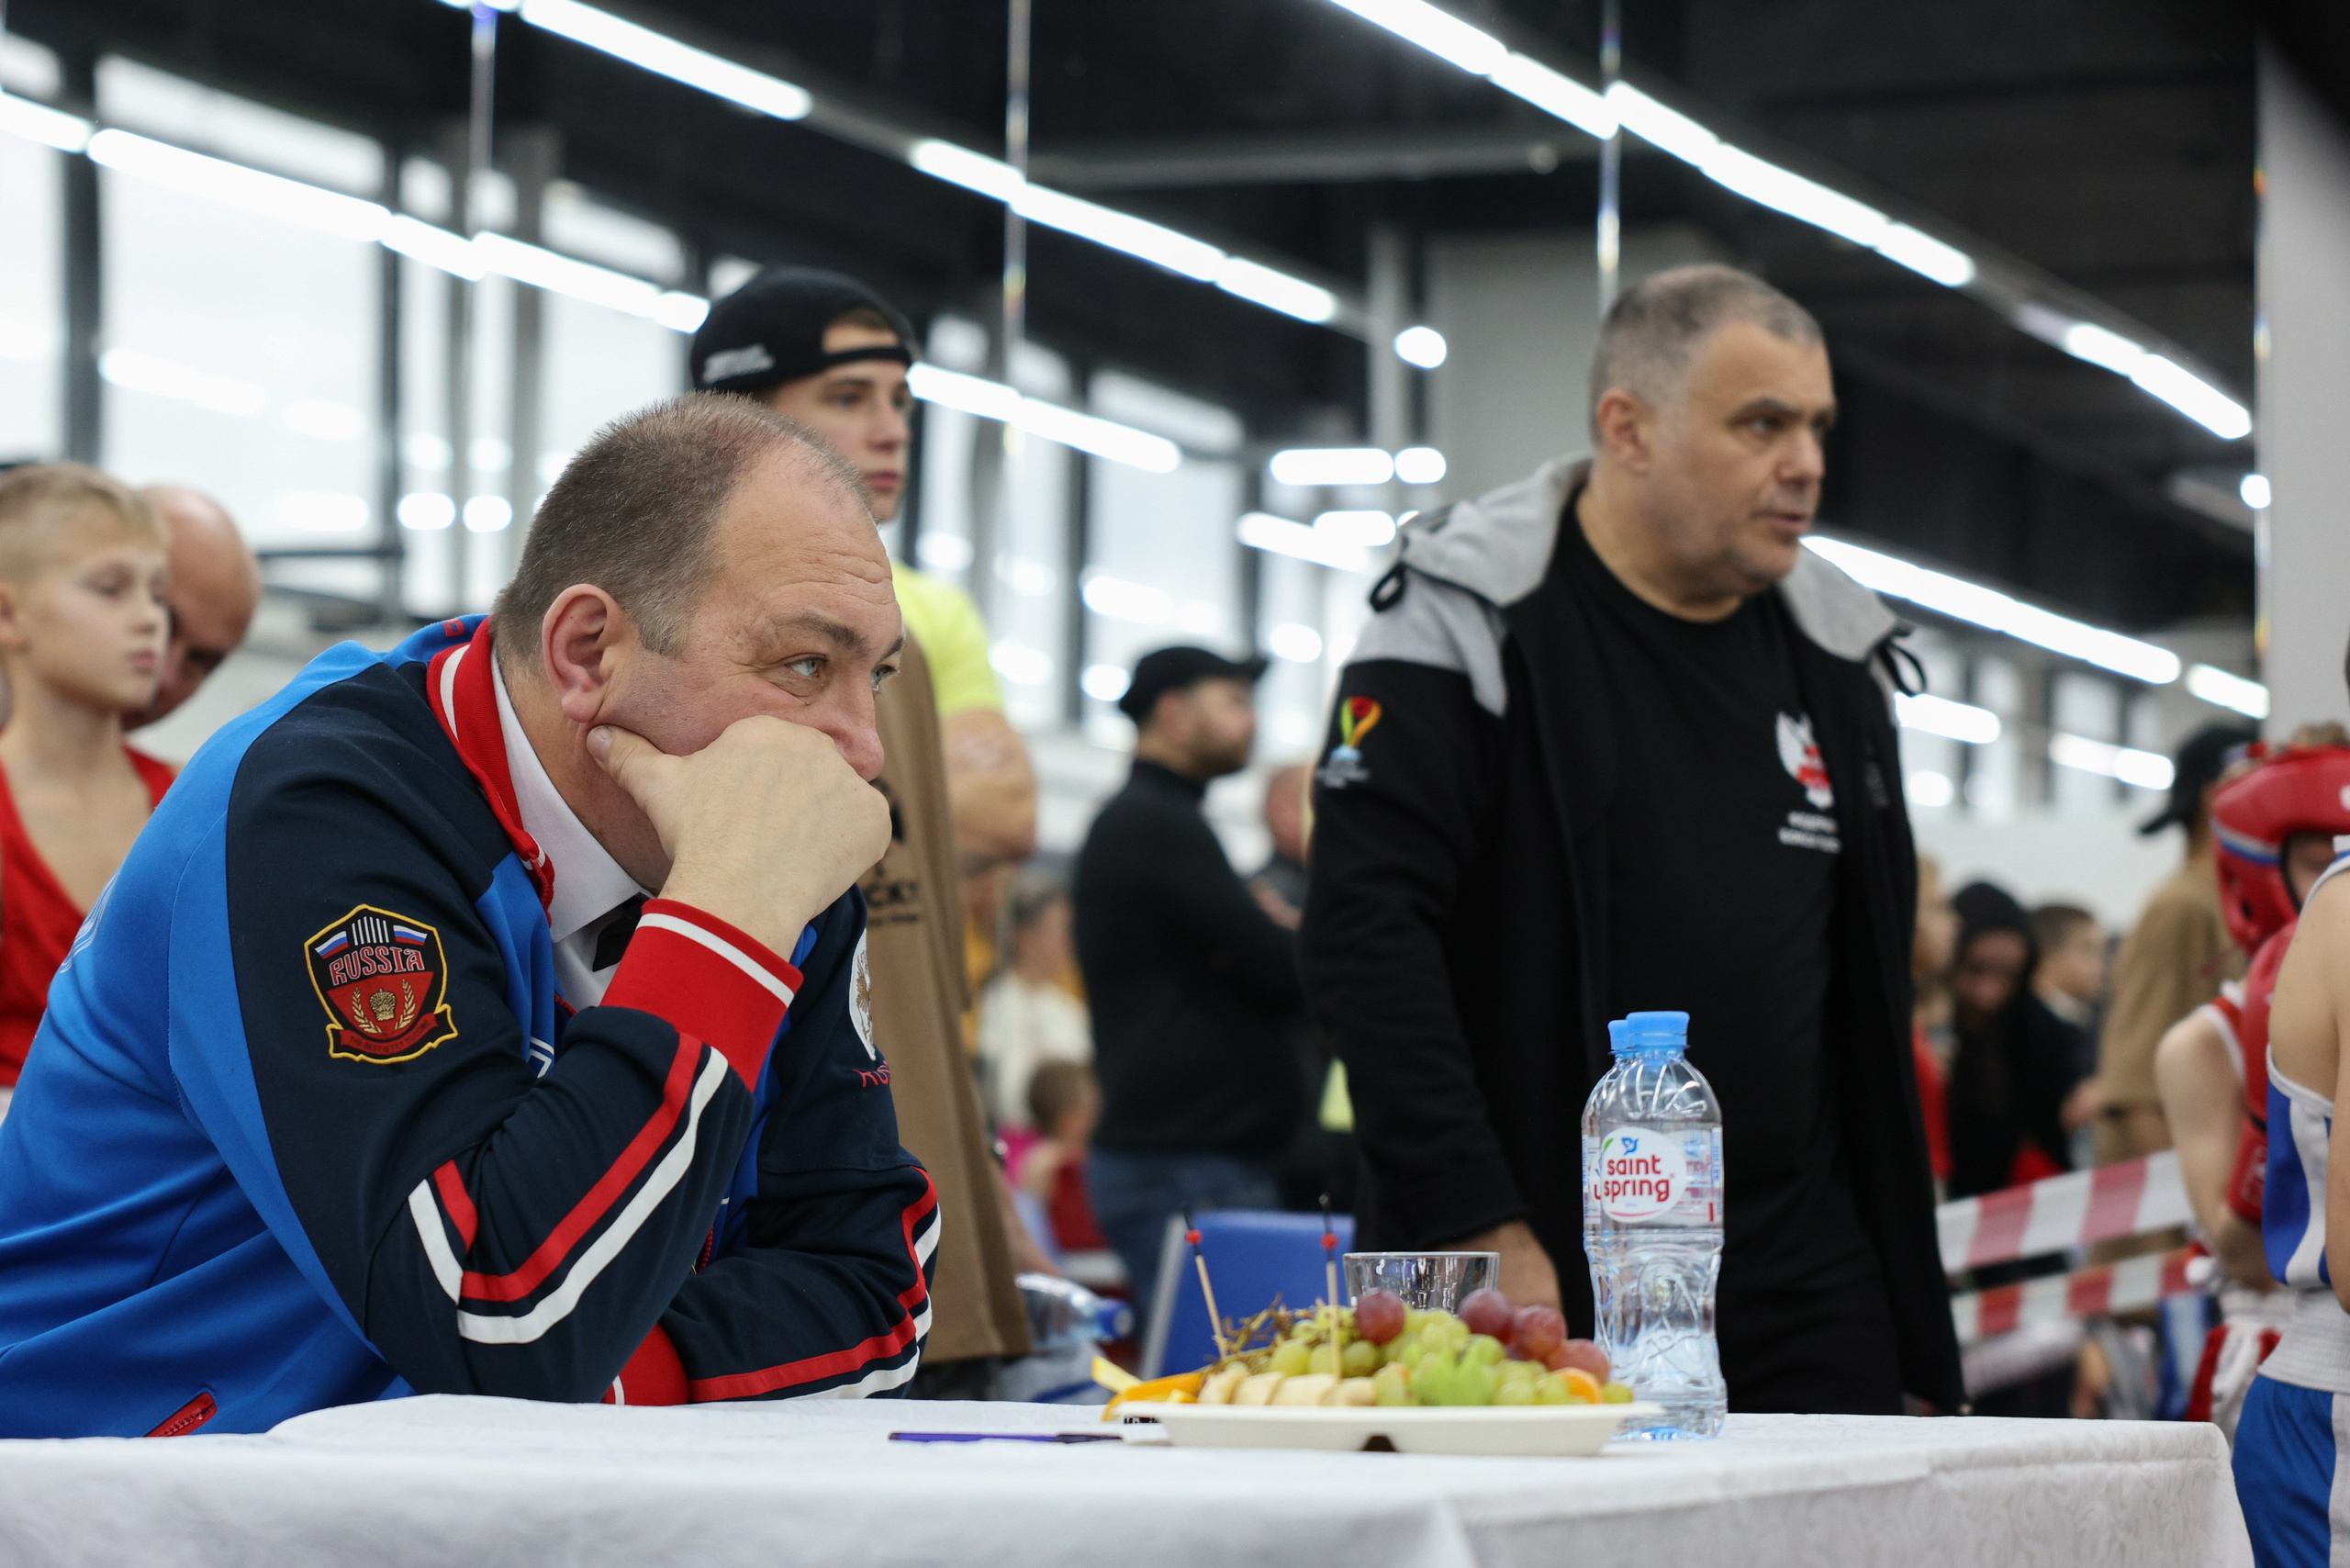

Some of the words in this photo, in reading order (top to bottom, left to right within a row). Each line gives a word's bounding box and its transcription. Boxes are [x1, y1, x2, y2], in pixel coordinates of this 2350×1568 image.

[329, 946, 425, 986] RUSSIA
[1607, 1154, 1662, 1175] saint
[1604, 1179, 1670, 1203] spring
